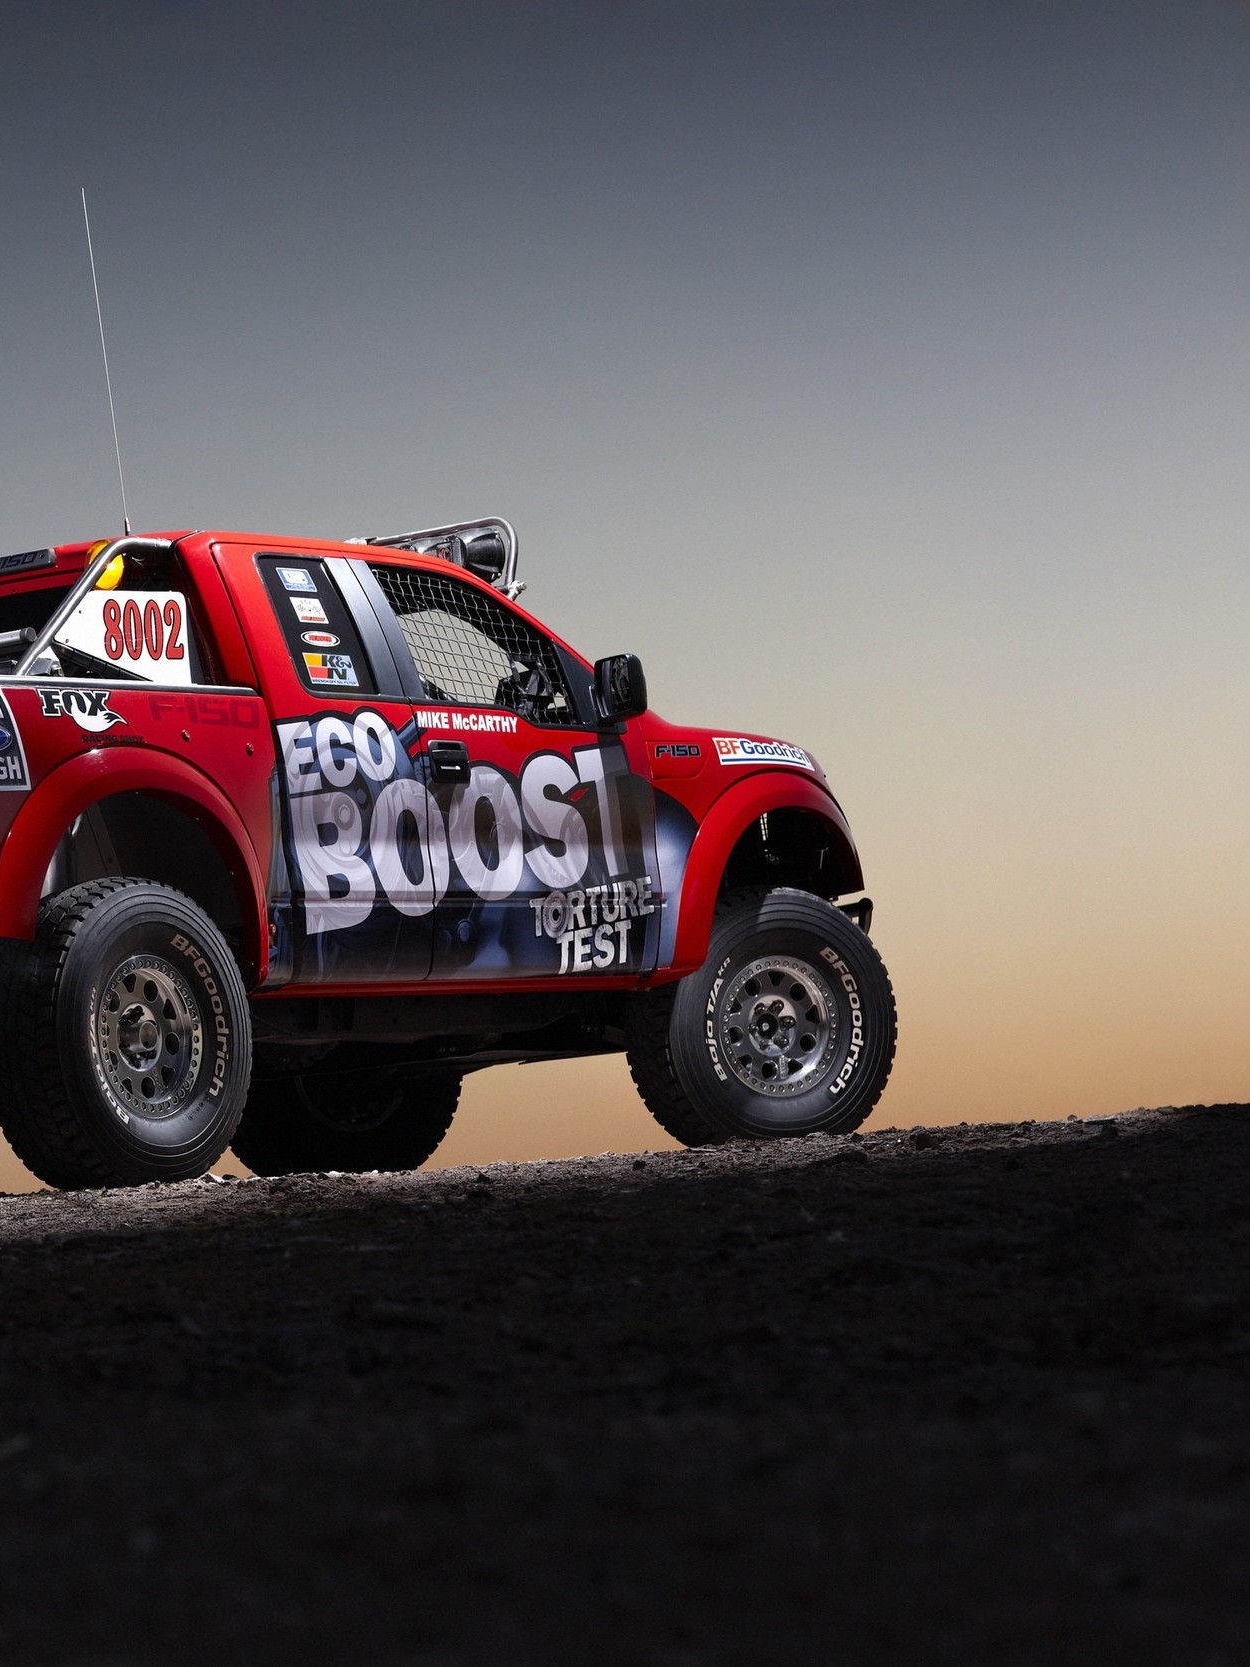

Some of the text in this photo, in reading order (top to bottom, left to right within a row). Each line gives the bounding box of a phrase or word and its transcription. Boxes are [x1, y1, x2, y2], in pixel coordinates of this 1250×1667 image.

[103, 599, 185, 660] 8002
[38, 689, 109, 716] FOX
[148, 695, 260, 729] F-150
[417, 711, 517, 733] MIKE McCARTHY
[276, 711, 396, 794] ECO
[655, 744, 701, 758] F-150
[715, 739, 811, 764] BFGoodrich
[290, 745, 631, 935] BOOST
[529, 876, 655, 938] TORTURE
[556, 920, 632, 975] TEST
[170, 934, 230, 1097] BFGoodrich
[706, 978, 724, 1015] T/A
[819, 946, 864, 1094] BFGoodrich
[705, 1024, 728, 1081] Baja
